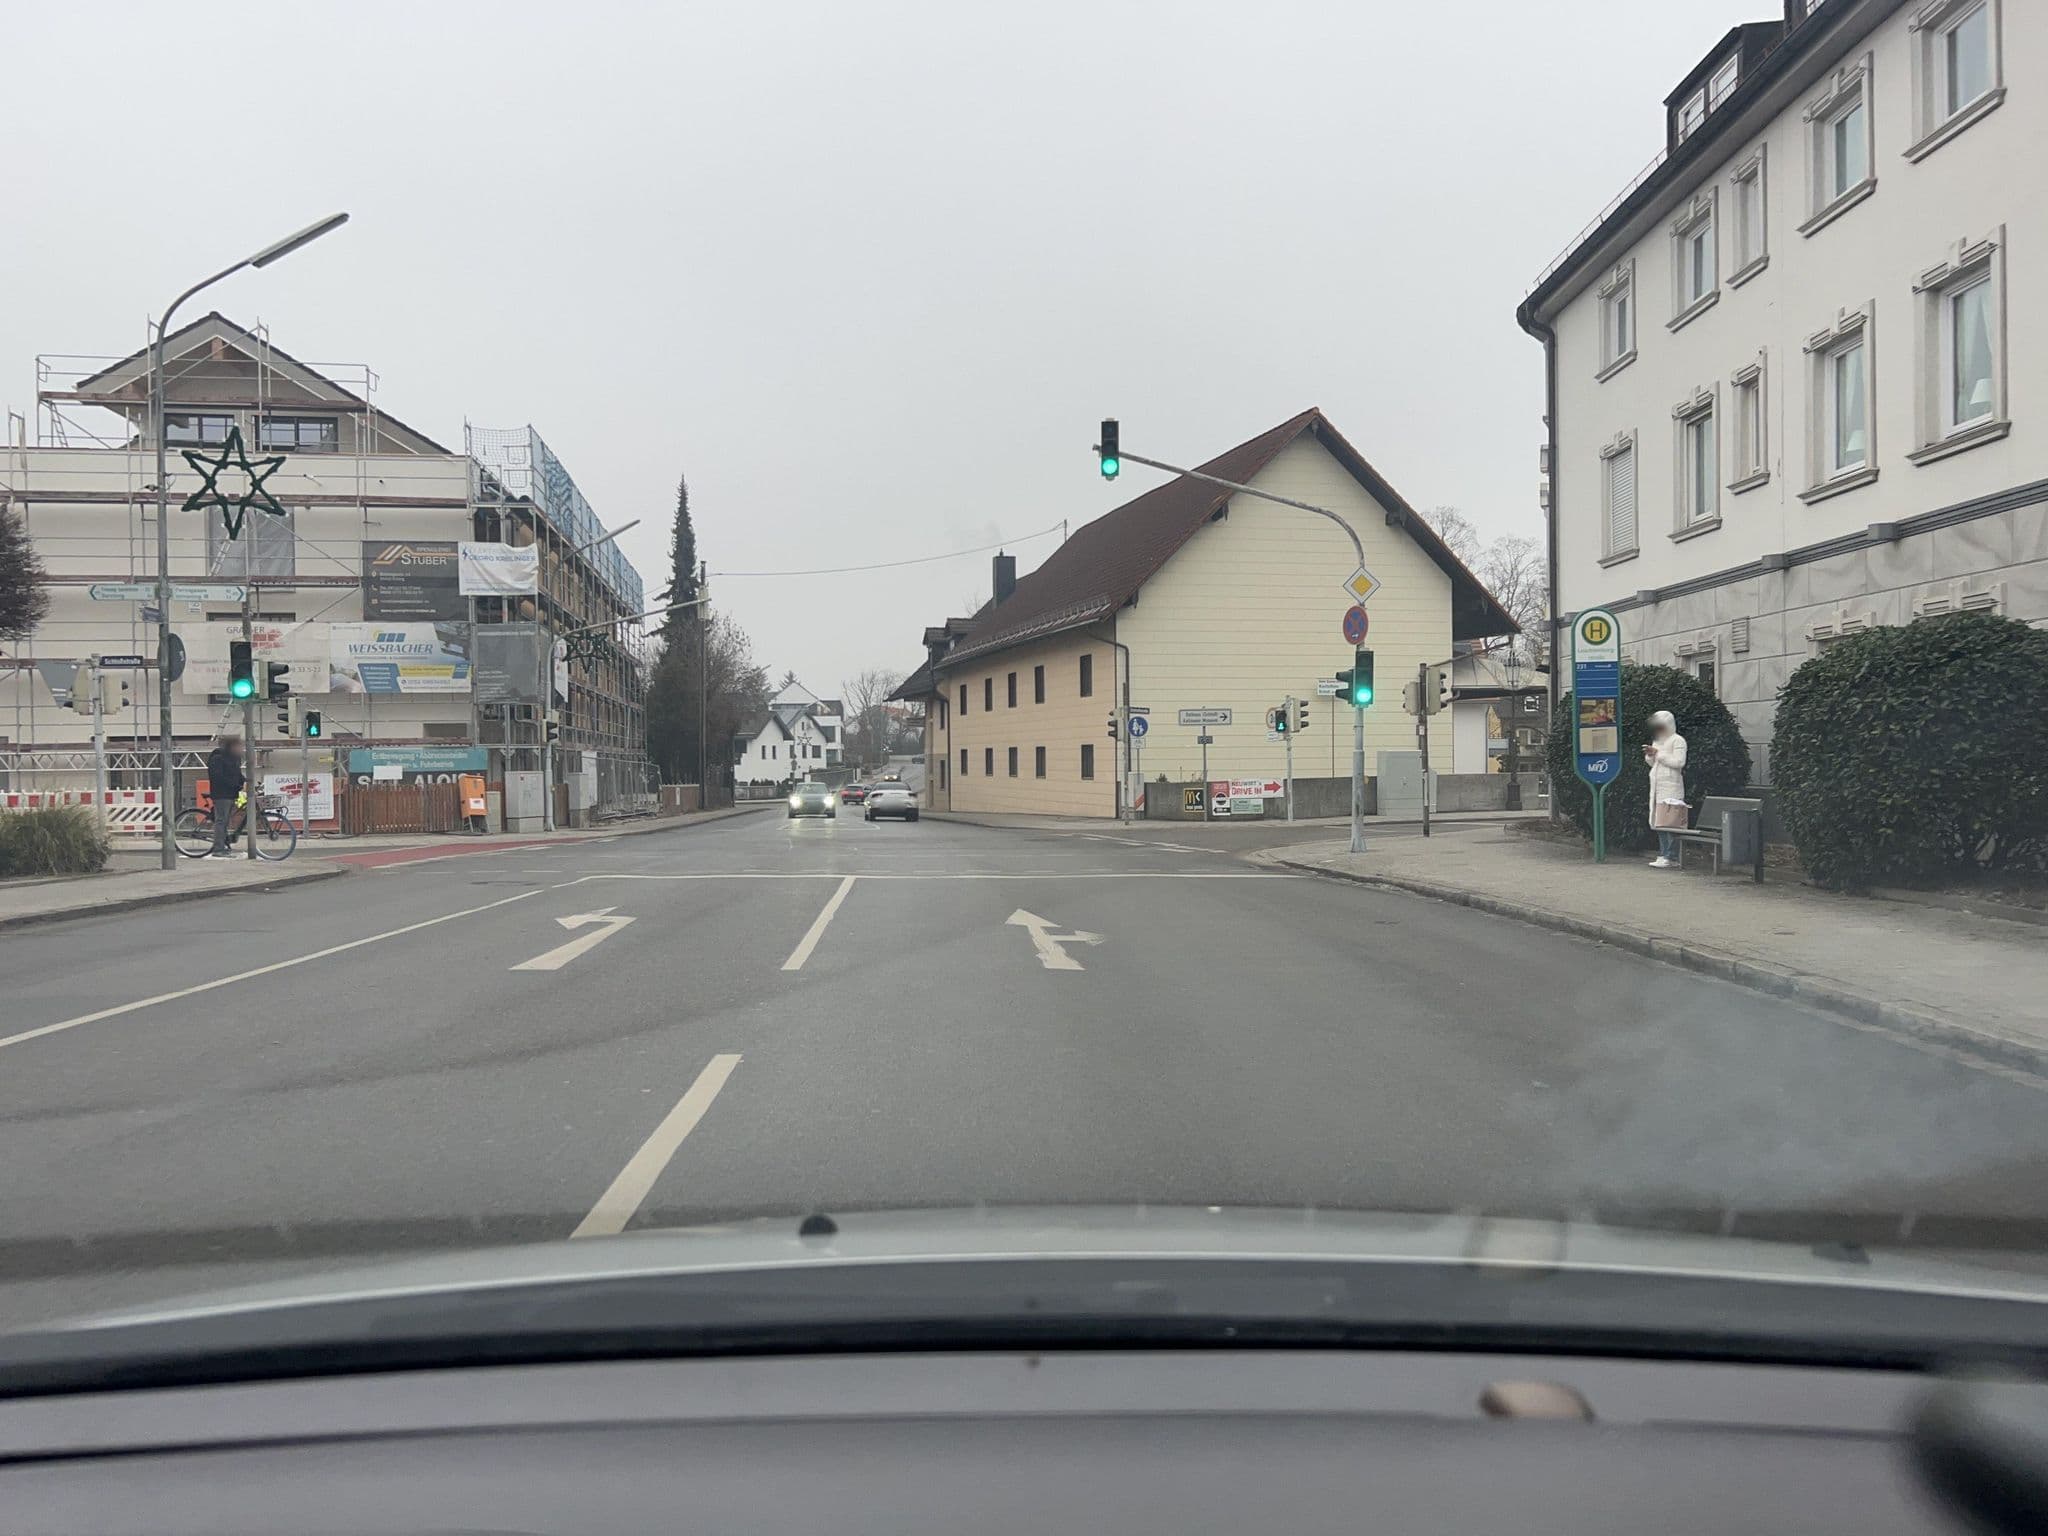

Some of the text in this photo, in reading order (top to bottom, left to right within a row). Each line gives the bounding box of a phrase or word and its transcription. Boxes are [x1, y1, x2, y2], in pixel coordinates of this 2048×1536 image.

[1590, 622, 1603, 639] H
[348, 643, 434, 655] WEISSBACHER
[1231, 787, 1262, 796] DRIVE IN
